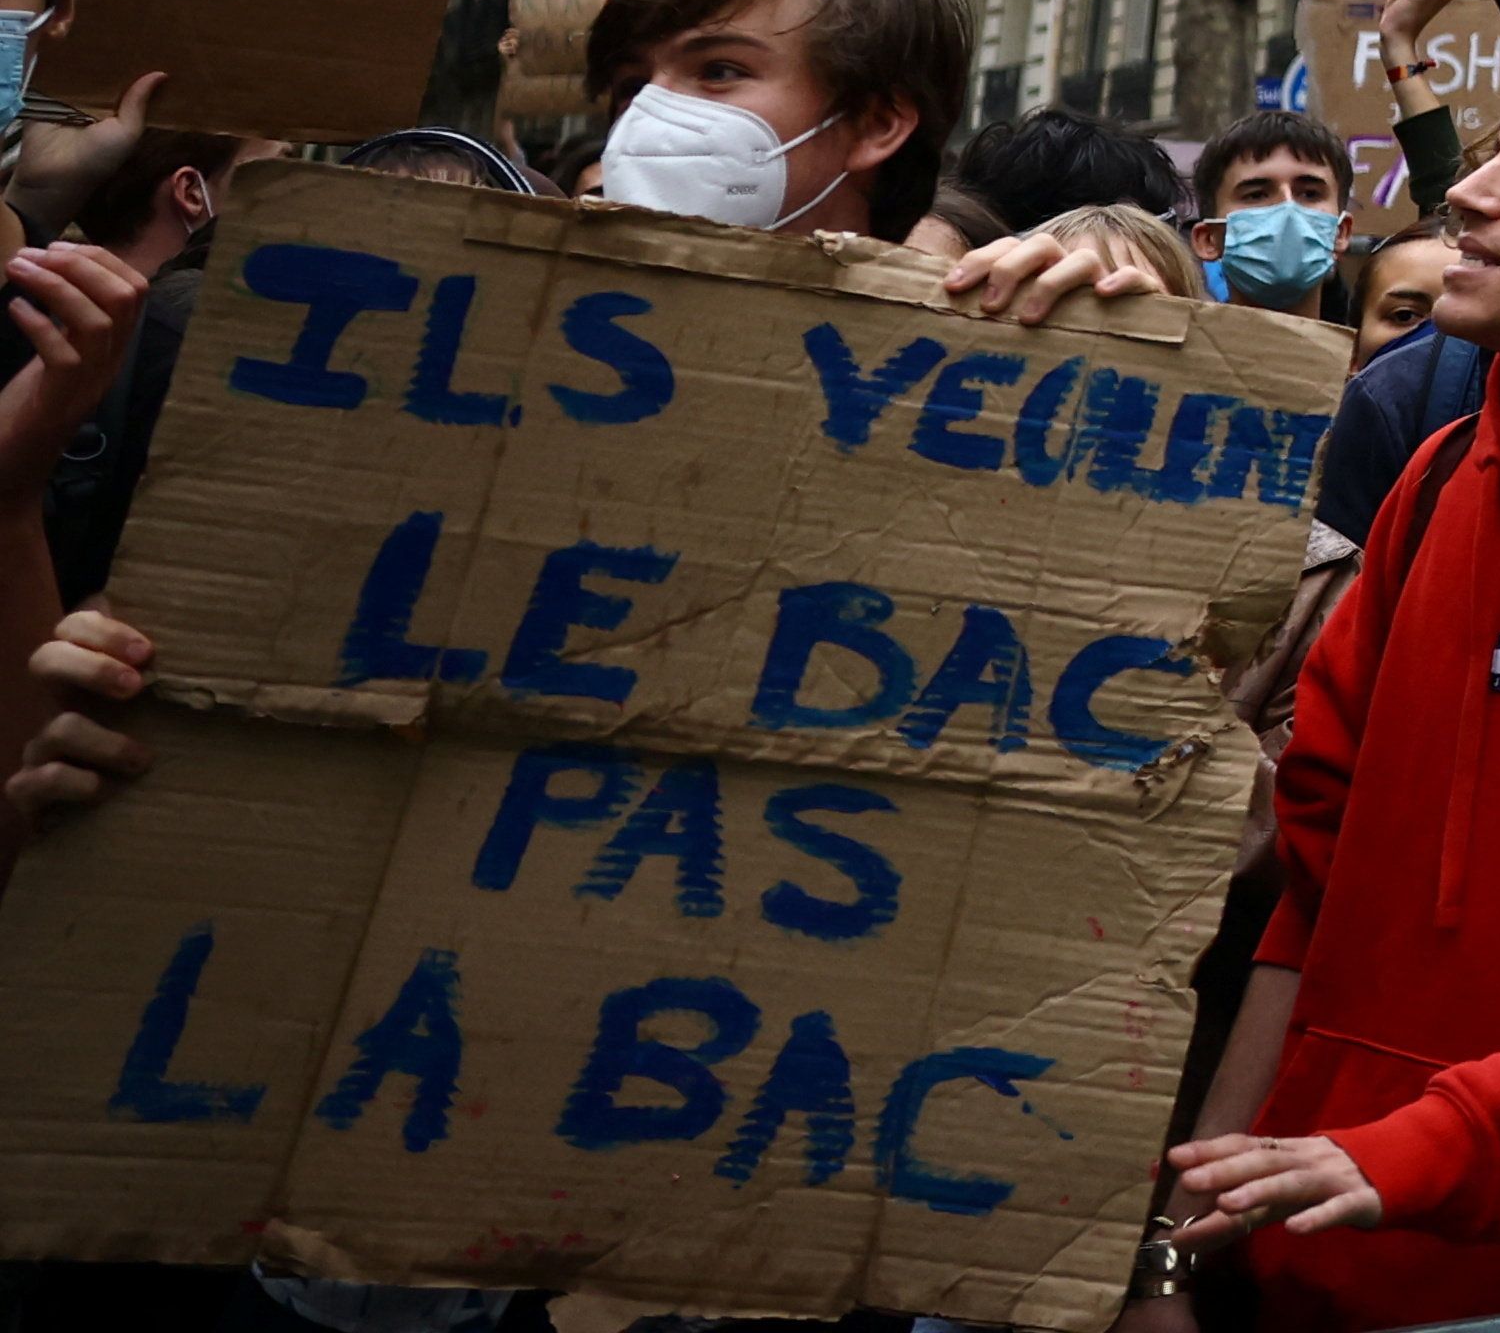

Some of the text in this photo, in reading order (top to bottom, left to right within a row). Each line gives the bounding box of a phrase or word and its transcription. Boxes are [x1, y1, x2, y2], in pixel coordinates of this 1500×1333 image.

[229, 240, 676, 427] ILS
[340, 509, 1200, 773] LE BAC
[471, 739, 902, 943] PAS
[106, 919, 1058, 1217] LA BAC
